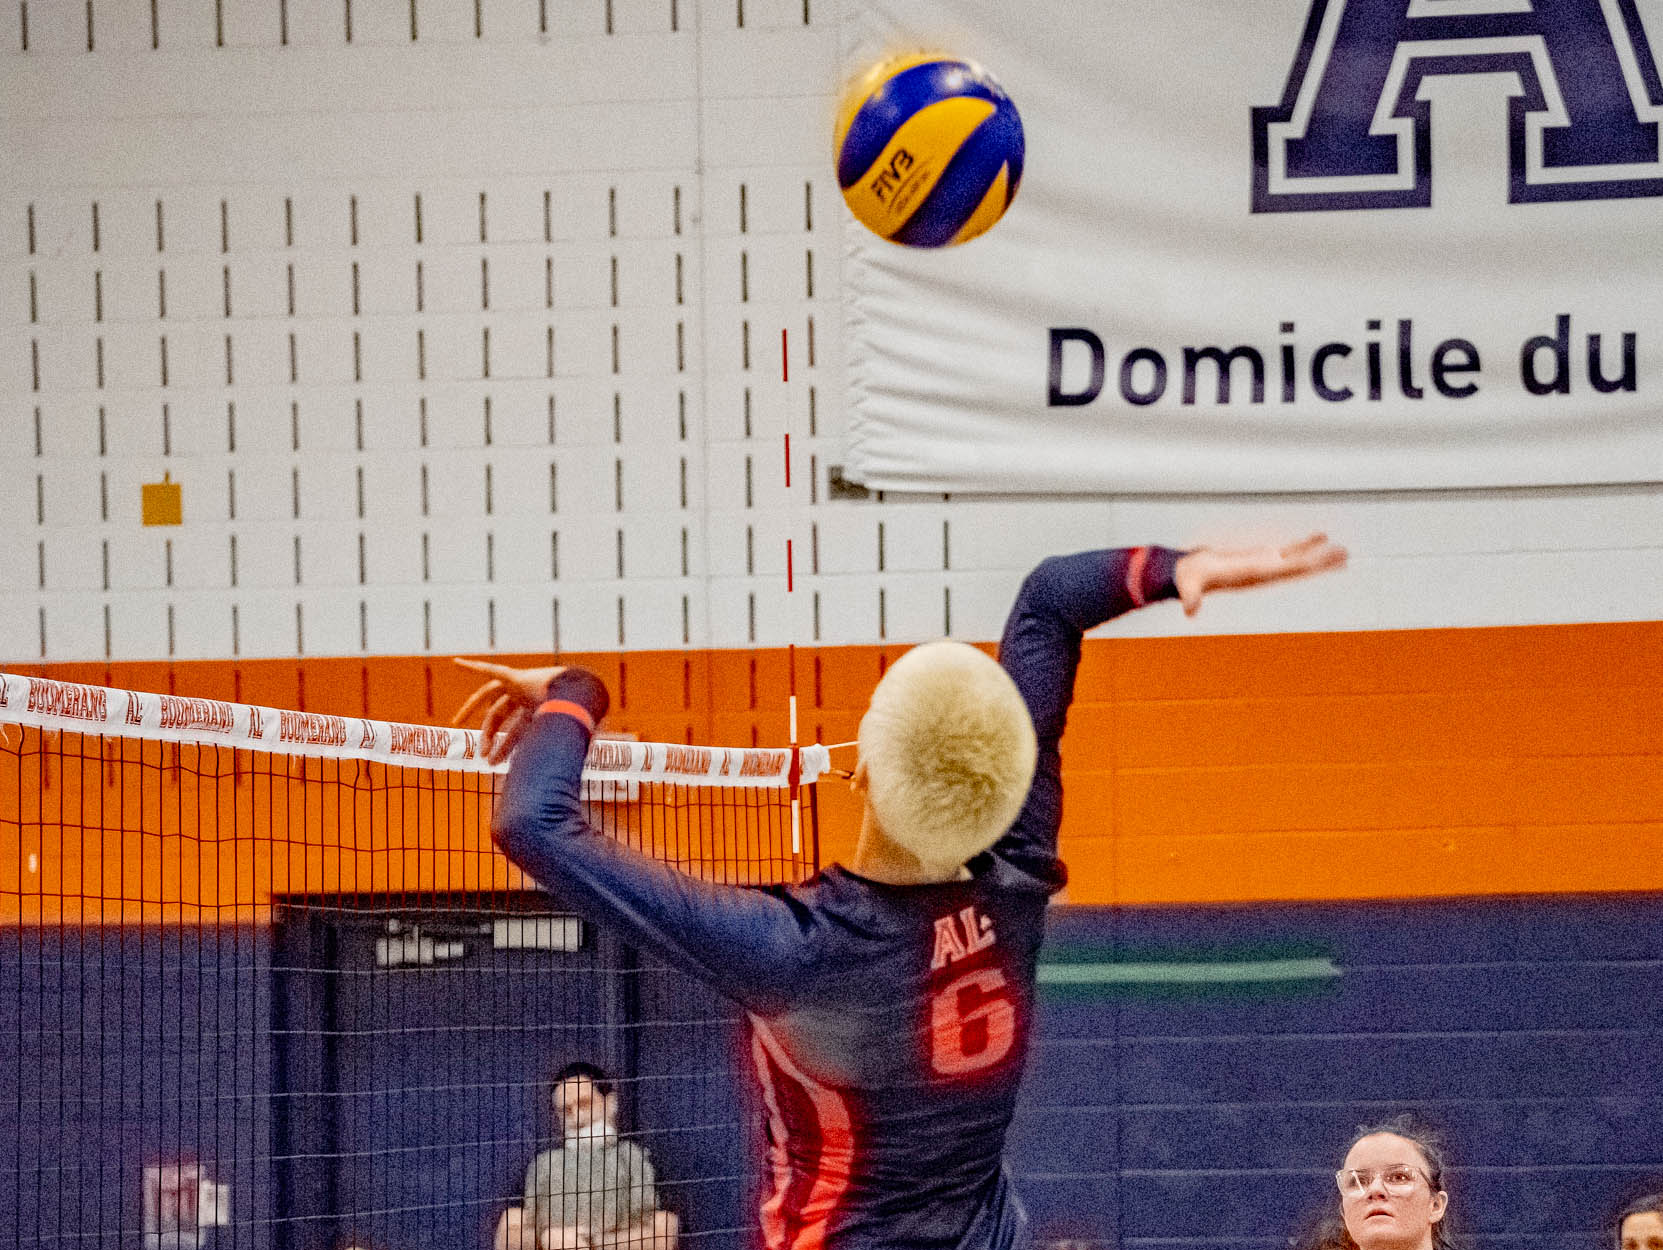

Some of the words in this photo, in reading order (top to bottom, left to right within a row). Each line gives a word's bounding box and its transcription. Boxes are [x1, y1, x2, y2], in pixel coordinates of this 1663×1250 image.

[1048, 319, 1482, 407] Domicile
[1520, 313, 1638, 395] du
[27, 679, 107, 721] BOOMERANG
[160, 695, 234, 733] BOOMERANG
[280, 710, 347, 746] BOOMERANG
[931, 907, 996, 970] AL
[931, 968, 1016, 1074] 6
